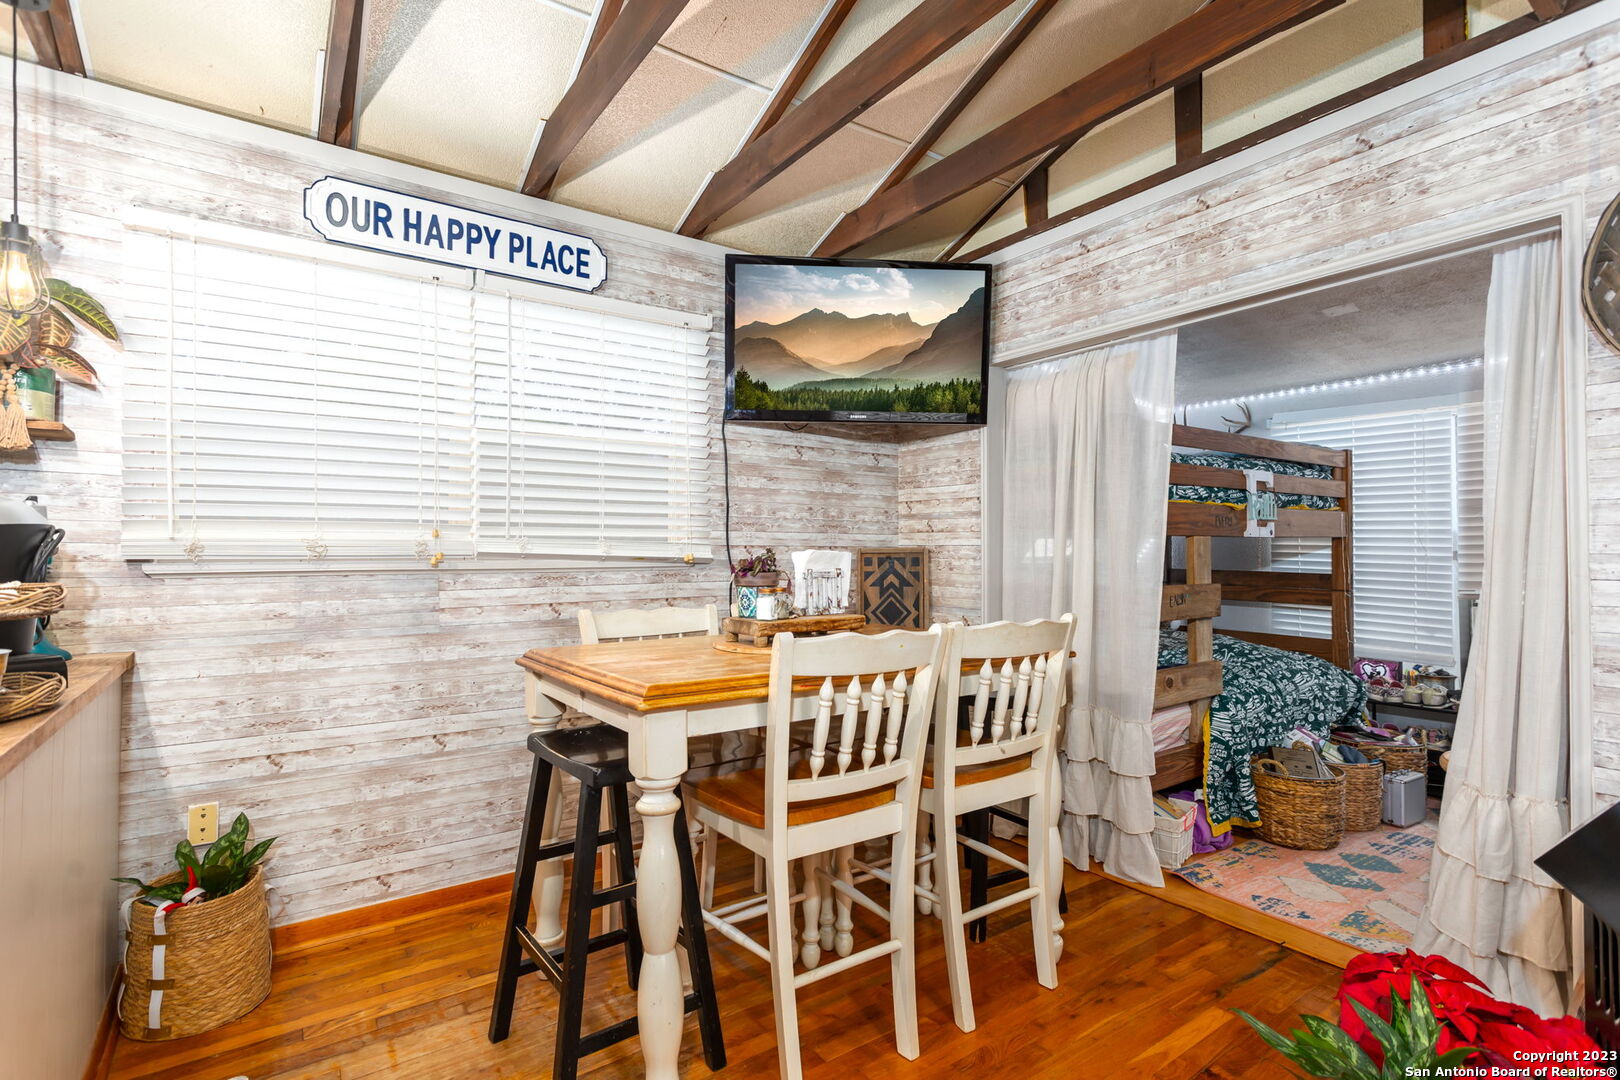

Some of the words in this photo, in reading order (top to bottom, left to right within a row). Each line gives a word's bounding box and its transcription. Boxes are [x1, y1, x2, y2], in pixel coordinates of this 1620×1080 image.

[325, 191, 394, 239] OUR
[403, 207, 502, 260] HAPPY
[508, 232, 591, 280] PLACE
